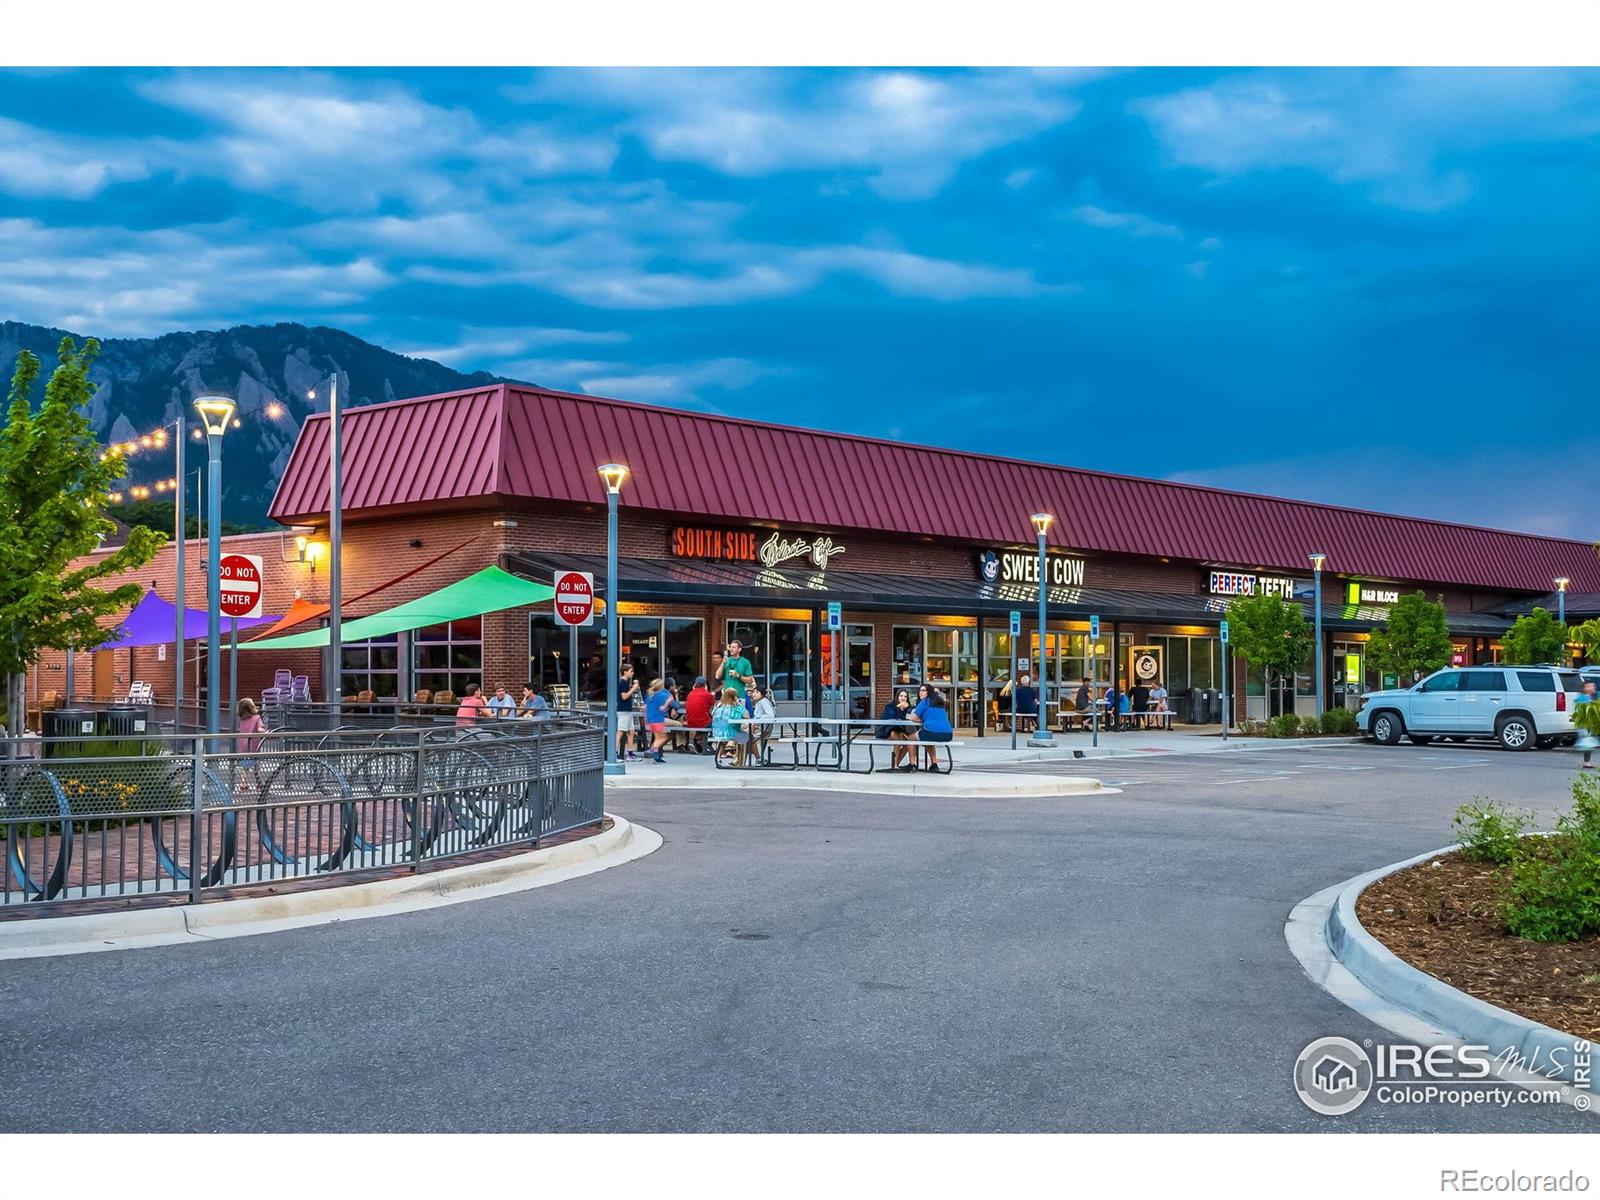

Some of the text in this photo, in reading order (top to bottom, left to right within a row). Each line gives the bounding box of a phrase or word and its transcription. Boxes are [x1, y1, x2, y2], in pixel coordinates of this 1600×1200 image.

[676, 527, 721, 558] SOUTH
[726, 531, 756, 560] SIDE
[219, 566, 255, 578] DO NOT
[1002, 553, 1085, 586] SWEET COW
[560, 582, 588, 592] DO NOT
[1210, 572, 1294, 599] PERFECT TEETH
[221, 593, 251, 605] ENTER
[1376, 590, 1399, 604] BLOCK
[563, 605, 586, 615] ENTER
